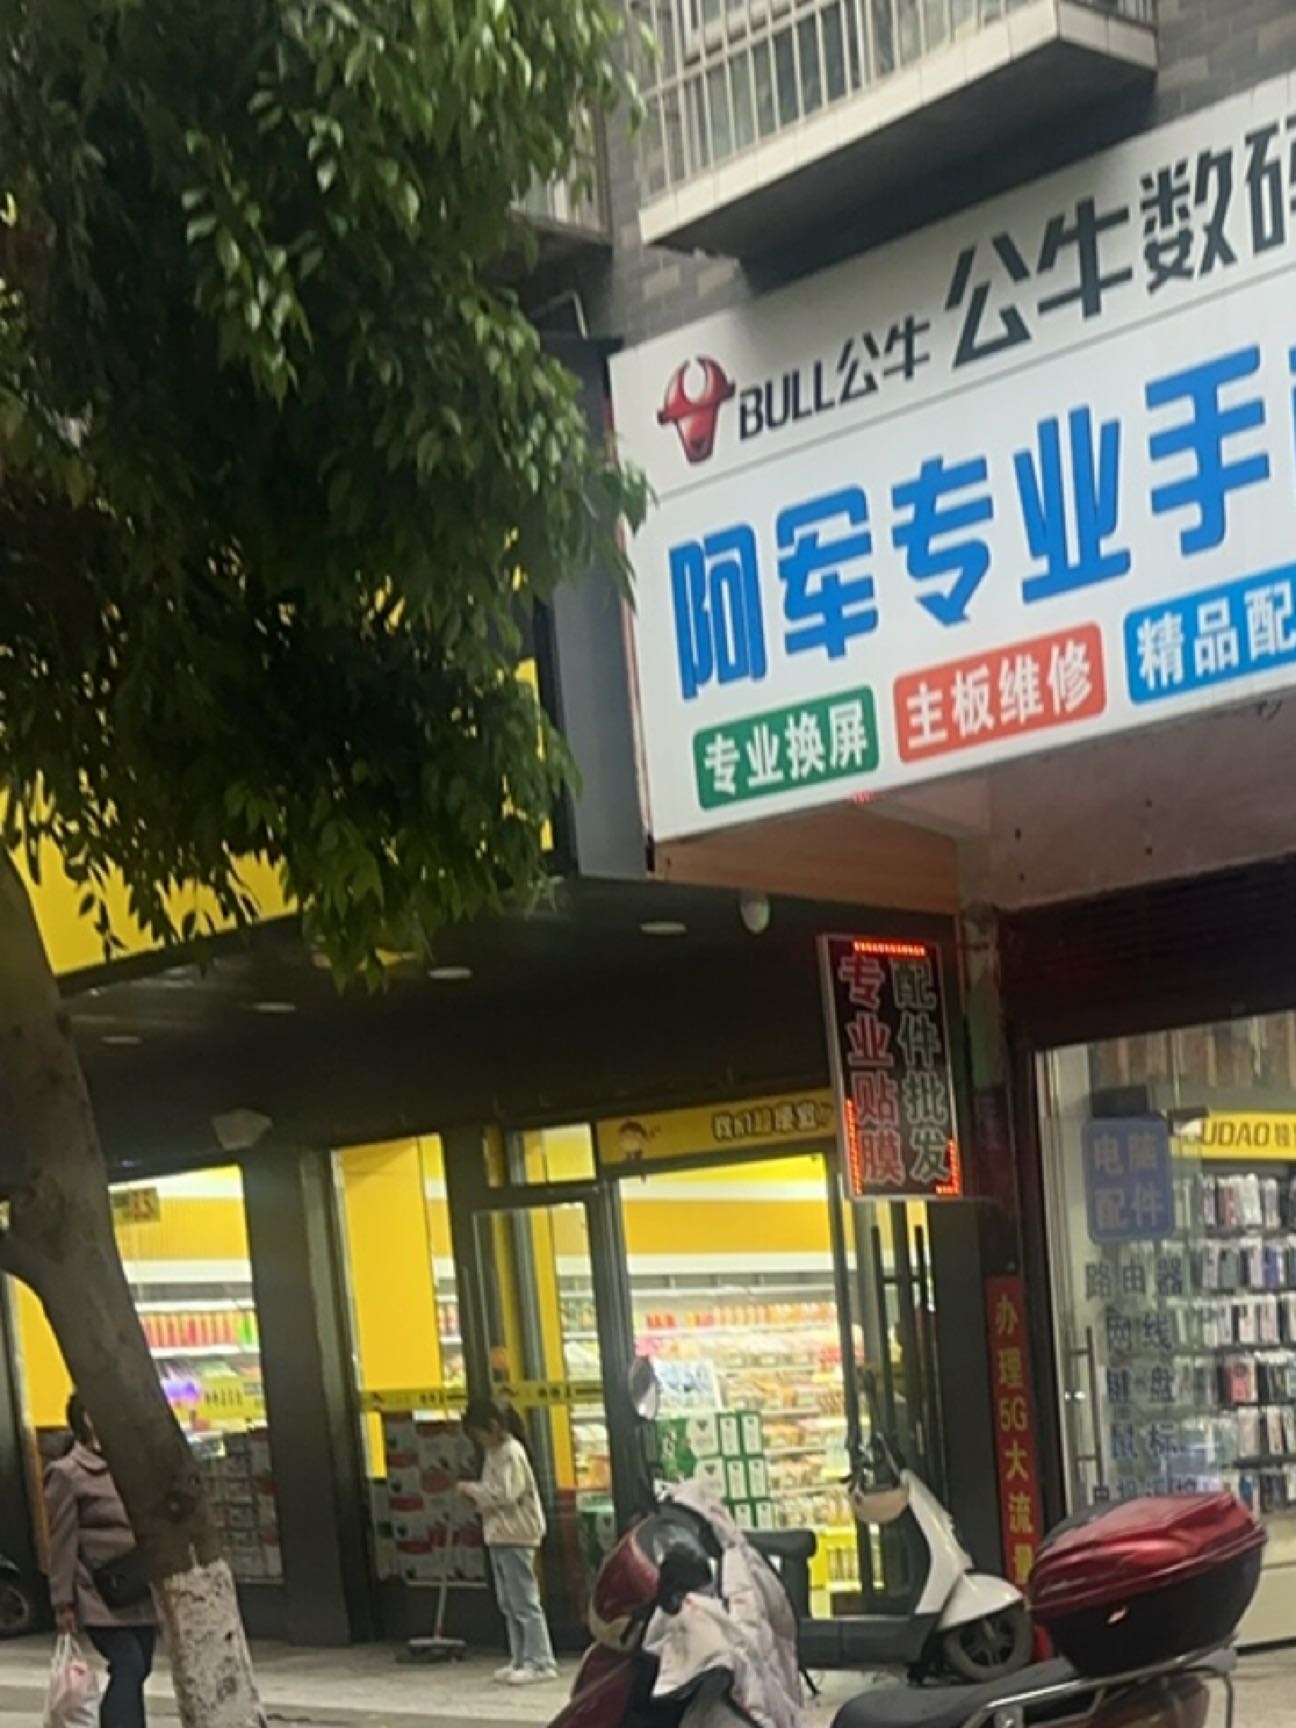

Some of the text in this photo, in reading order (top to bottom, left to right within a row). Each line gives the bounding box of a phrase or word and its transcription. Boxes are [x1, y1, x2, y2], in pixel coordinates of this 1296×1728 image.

[905, 643, 1093, 750] 主板维修
[703, 705, 868, 794] 专业换屏
[837, 954, 905, 1186] 专业贴膜
[890, 957, 950, 1184] 配件批发
[1186, 1122, 1269, 1147] UDAO
[1094, 1184, 1164, 1230] 配件
[1086, 1257, 1183, 1299] 路由器
[1106, 1313, 1172, 1351] 网线
[1107, 1367, 1173, 1401] 键盘
